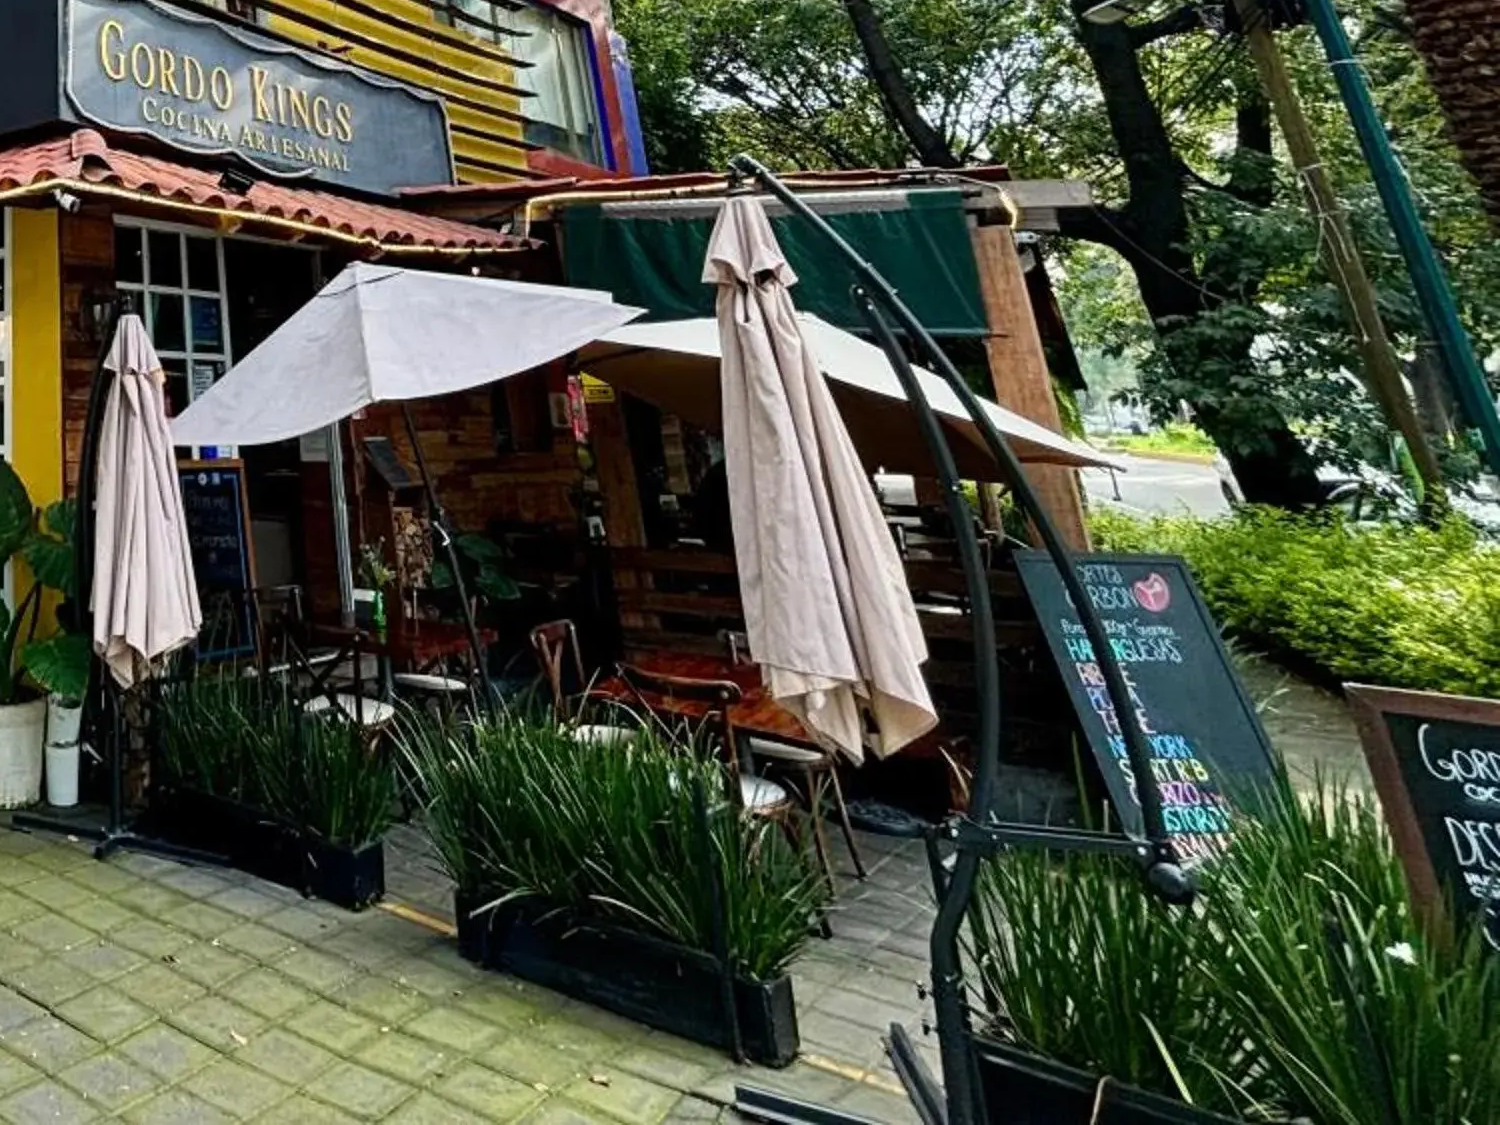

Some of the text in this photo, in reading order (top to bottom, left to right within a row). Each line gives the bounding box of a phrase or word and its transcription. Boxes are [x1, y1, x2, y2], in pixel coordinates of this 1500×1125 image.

[99, 19, 353, 143] GORDO KINGS
[142, 96, 351, 173] COCINA ARTESANAL
